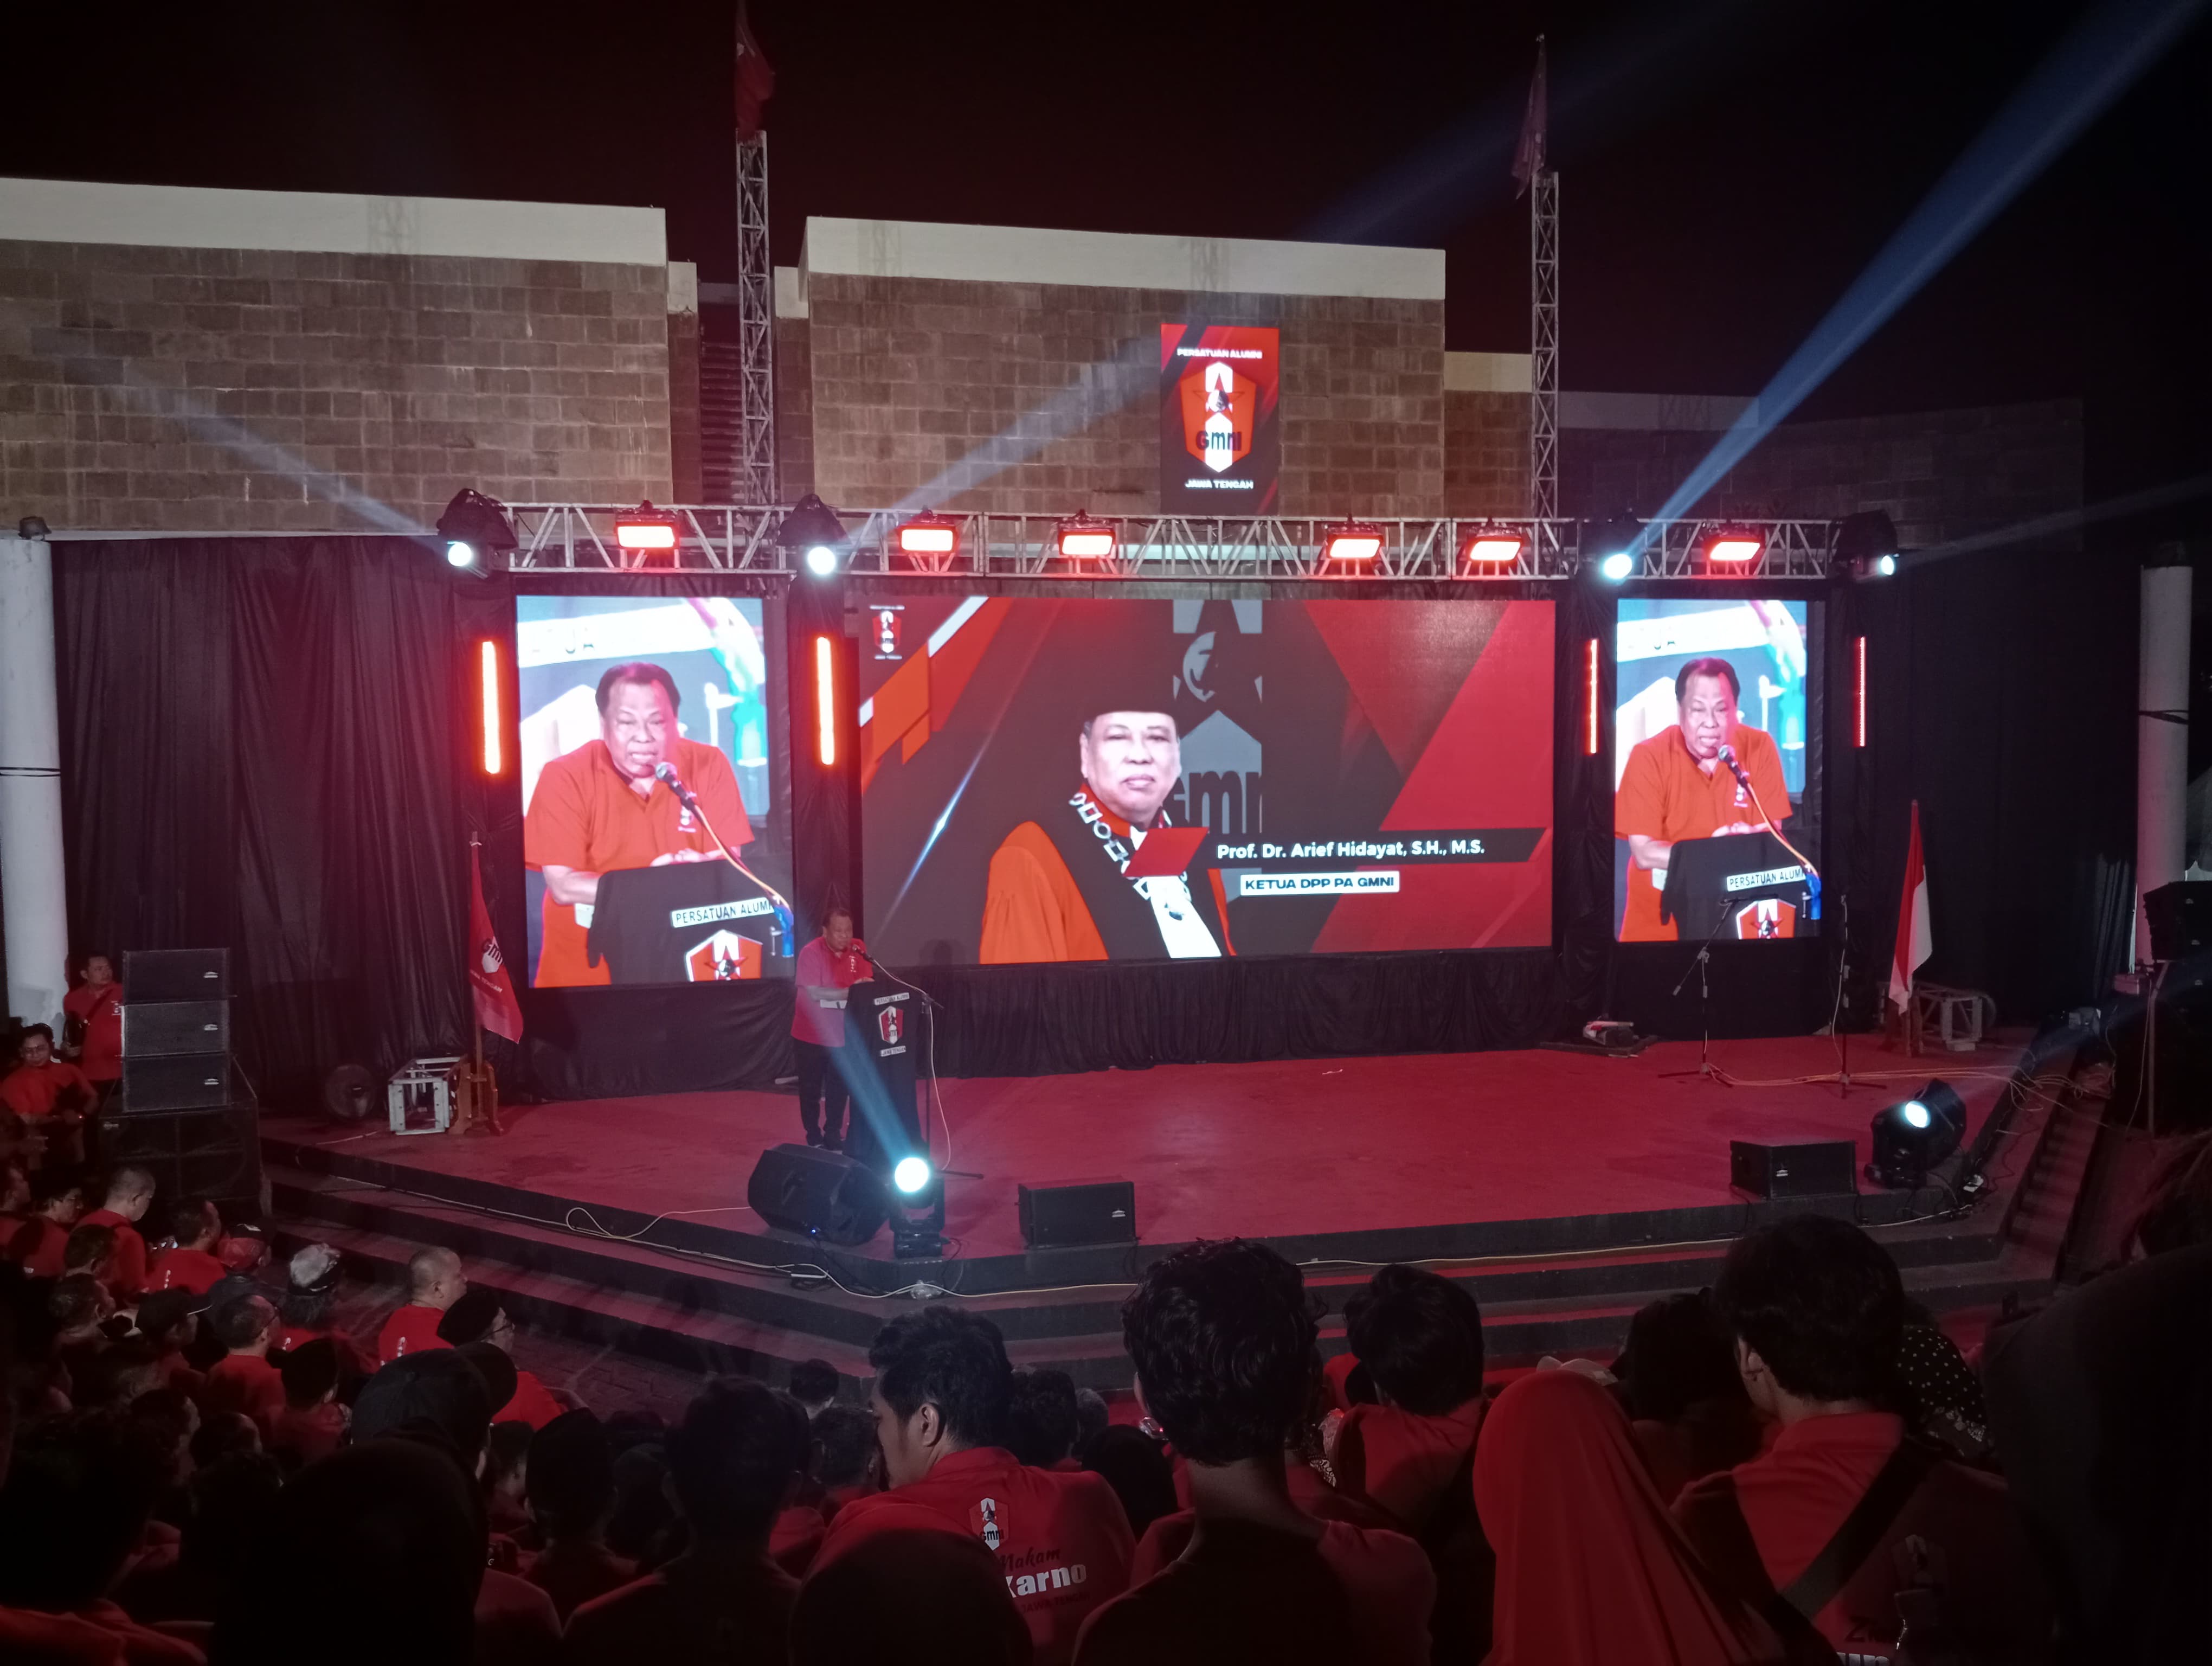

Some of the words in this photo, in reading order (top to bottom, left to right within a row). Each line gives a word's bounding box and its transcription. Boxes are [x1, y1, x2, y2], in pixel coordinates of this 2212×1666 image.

[1213, 479, 1253, 489] TENGAH
[1218, 842, 1258, 859] Prof.
[1262, 843, 1286, 858] Dr.
[1291, 842, 1334, 857] Arief
[1338, 840, 1407, 859] Hidayat,
[1411, 840, 1447, 856] S.H.,
[1451, 840, 1484, 855] M.S.
[1245, 880, 1296, 890] KETUA
[1301, 879, 1330, 889] DPP
[1334, 878, 1353, 888] PA
[1358, 877, 1394, 887] GMNI
[1730, 873, 1776, 887] PERSATUAN
[1780, 868, 1804, 880] ALUM
[676, 906, 736, 923] PERSATUAN
[741, 901, 771, 914] ALUM
